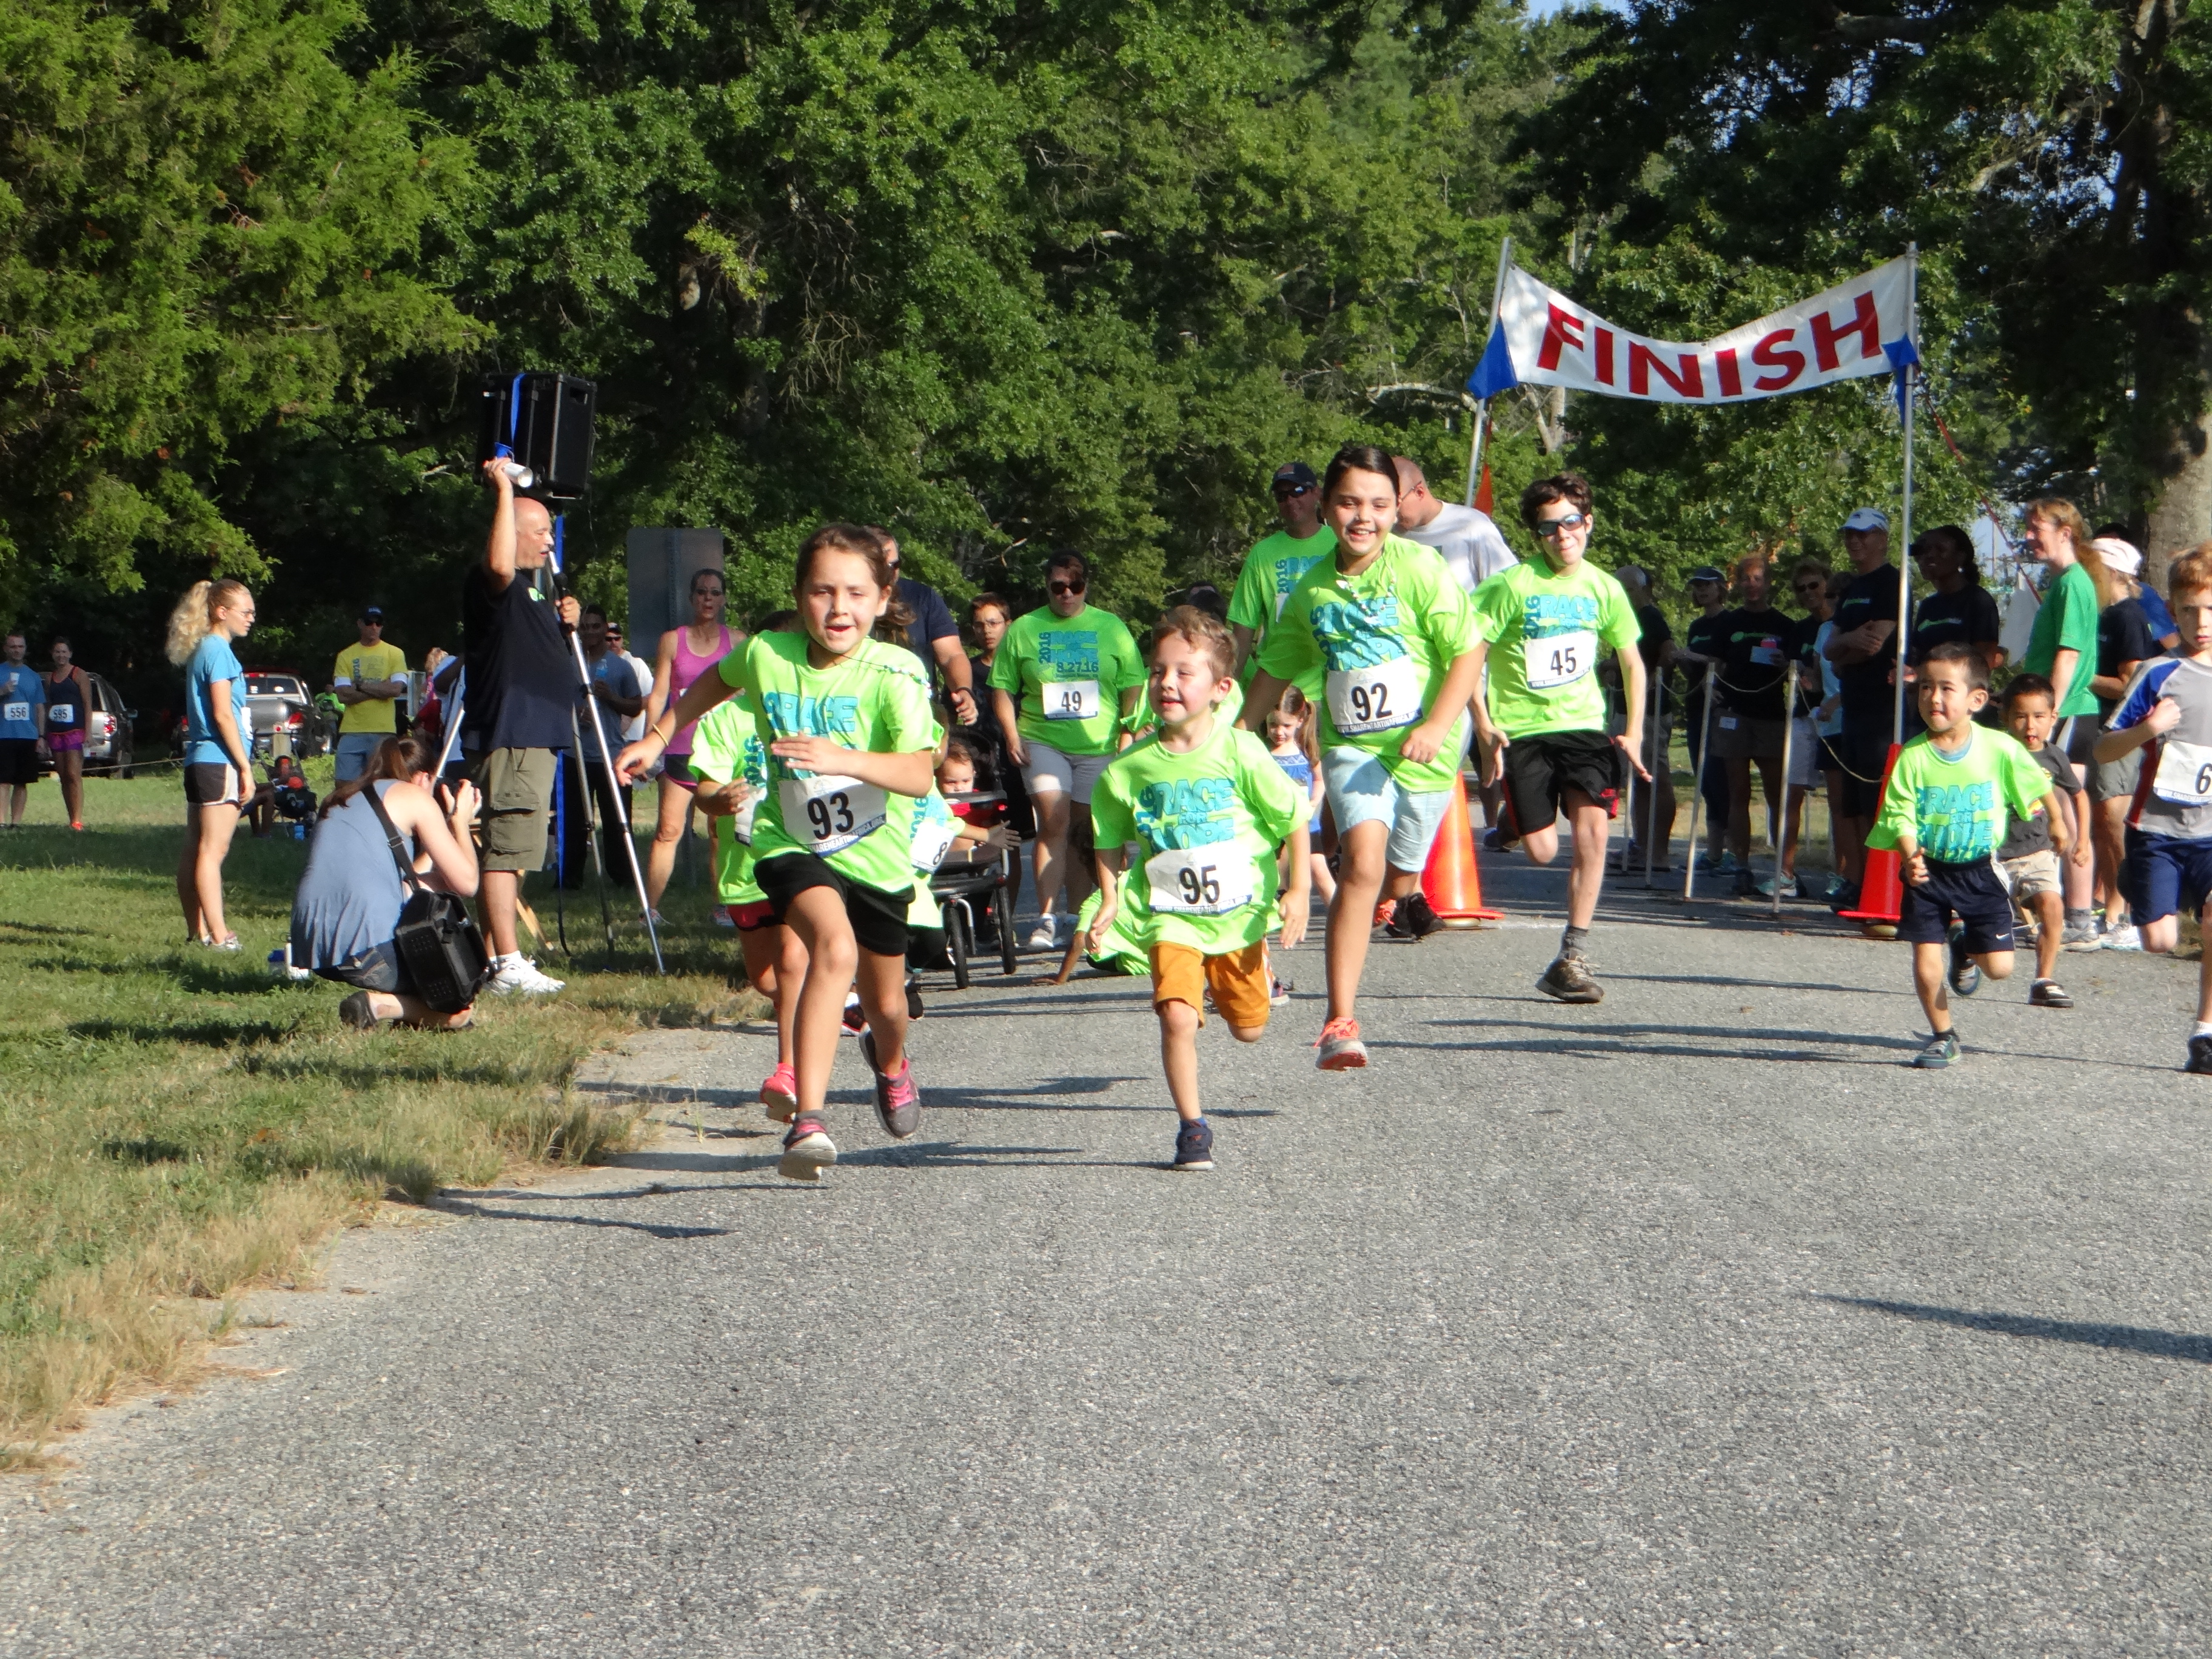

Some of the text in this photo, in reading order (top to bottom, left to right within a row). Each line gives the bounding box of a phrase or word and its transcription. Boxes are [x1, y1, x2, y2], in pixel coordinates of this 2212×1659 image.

[1536, 290, 1882, 398] FINISH
[1540, 594, 1597, 622] RACE
[1039, 632, 1051, 663] 2016
[1550, 646, 1577, 675] 45
[10, 707, 26, 717] 556
[53, 709, 68, 719] 595
[1061, 691, 1082, 712] 49
[1351, 682, 1393, 722] 92
[2195, 763, 2212, 794] 6
[1152, 778, 1235, 819] RACE
[1923, 781, 1994, 815] RACE
[807, 792, 854, 840] 93
[1179, 864, 1220, 905] 95
